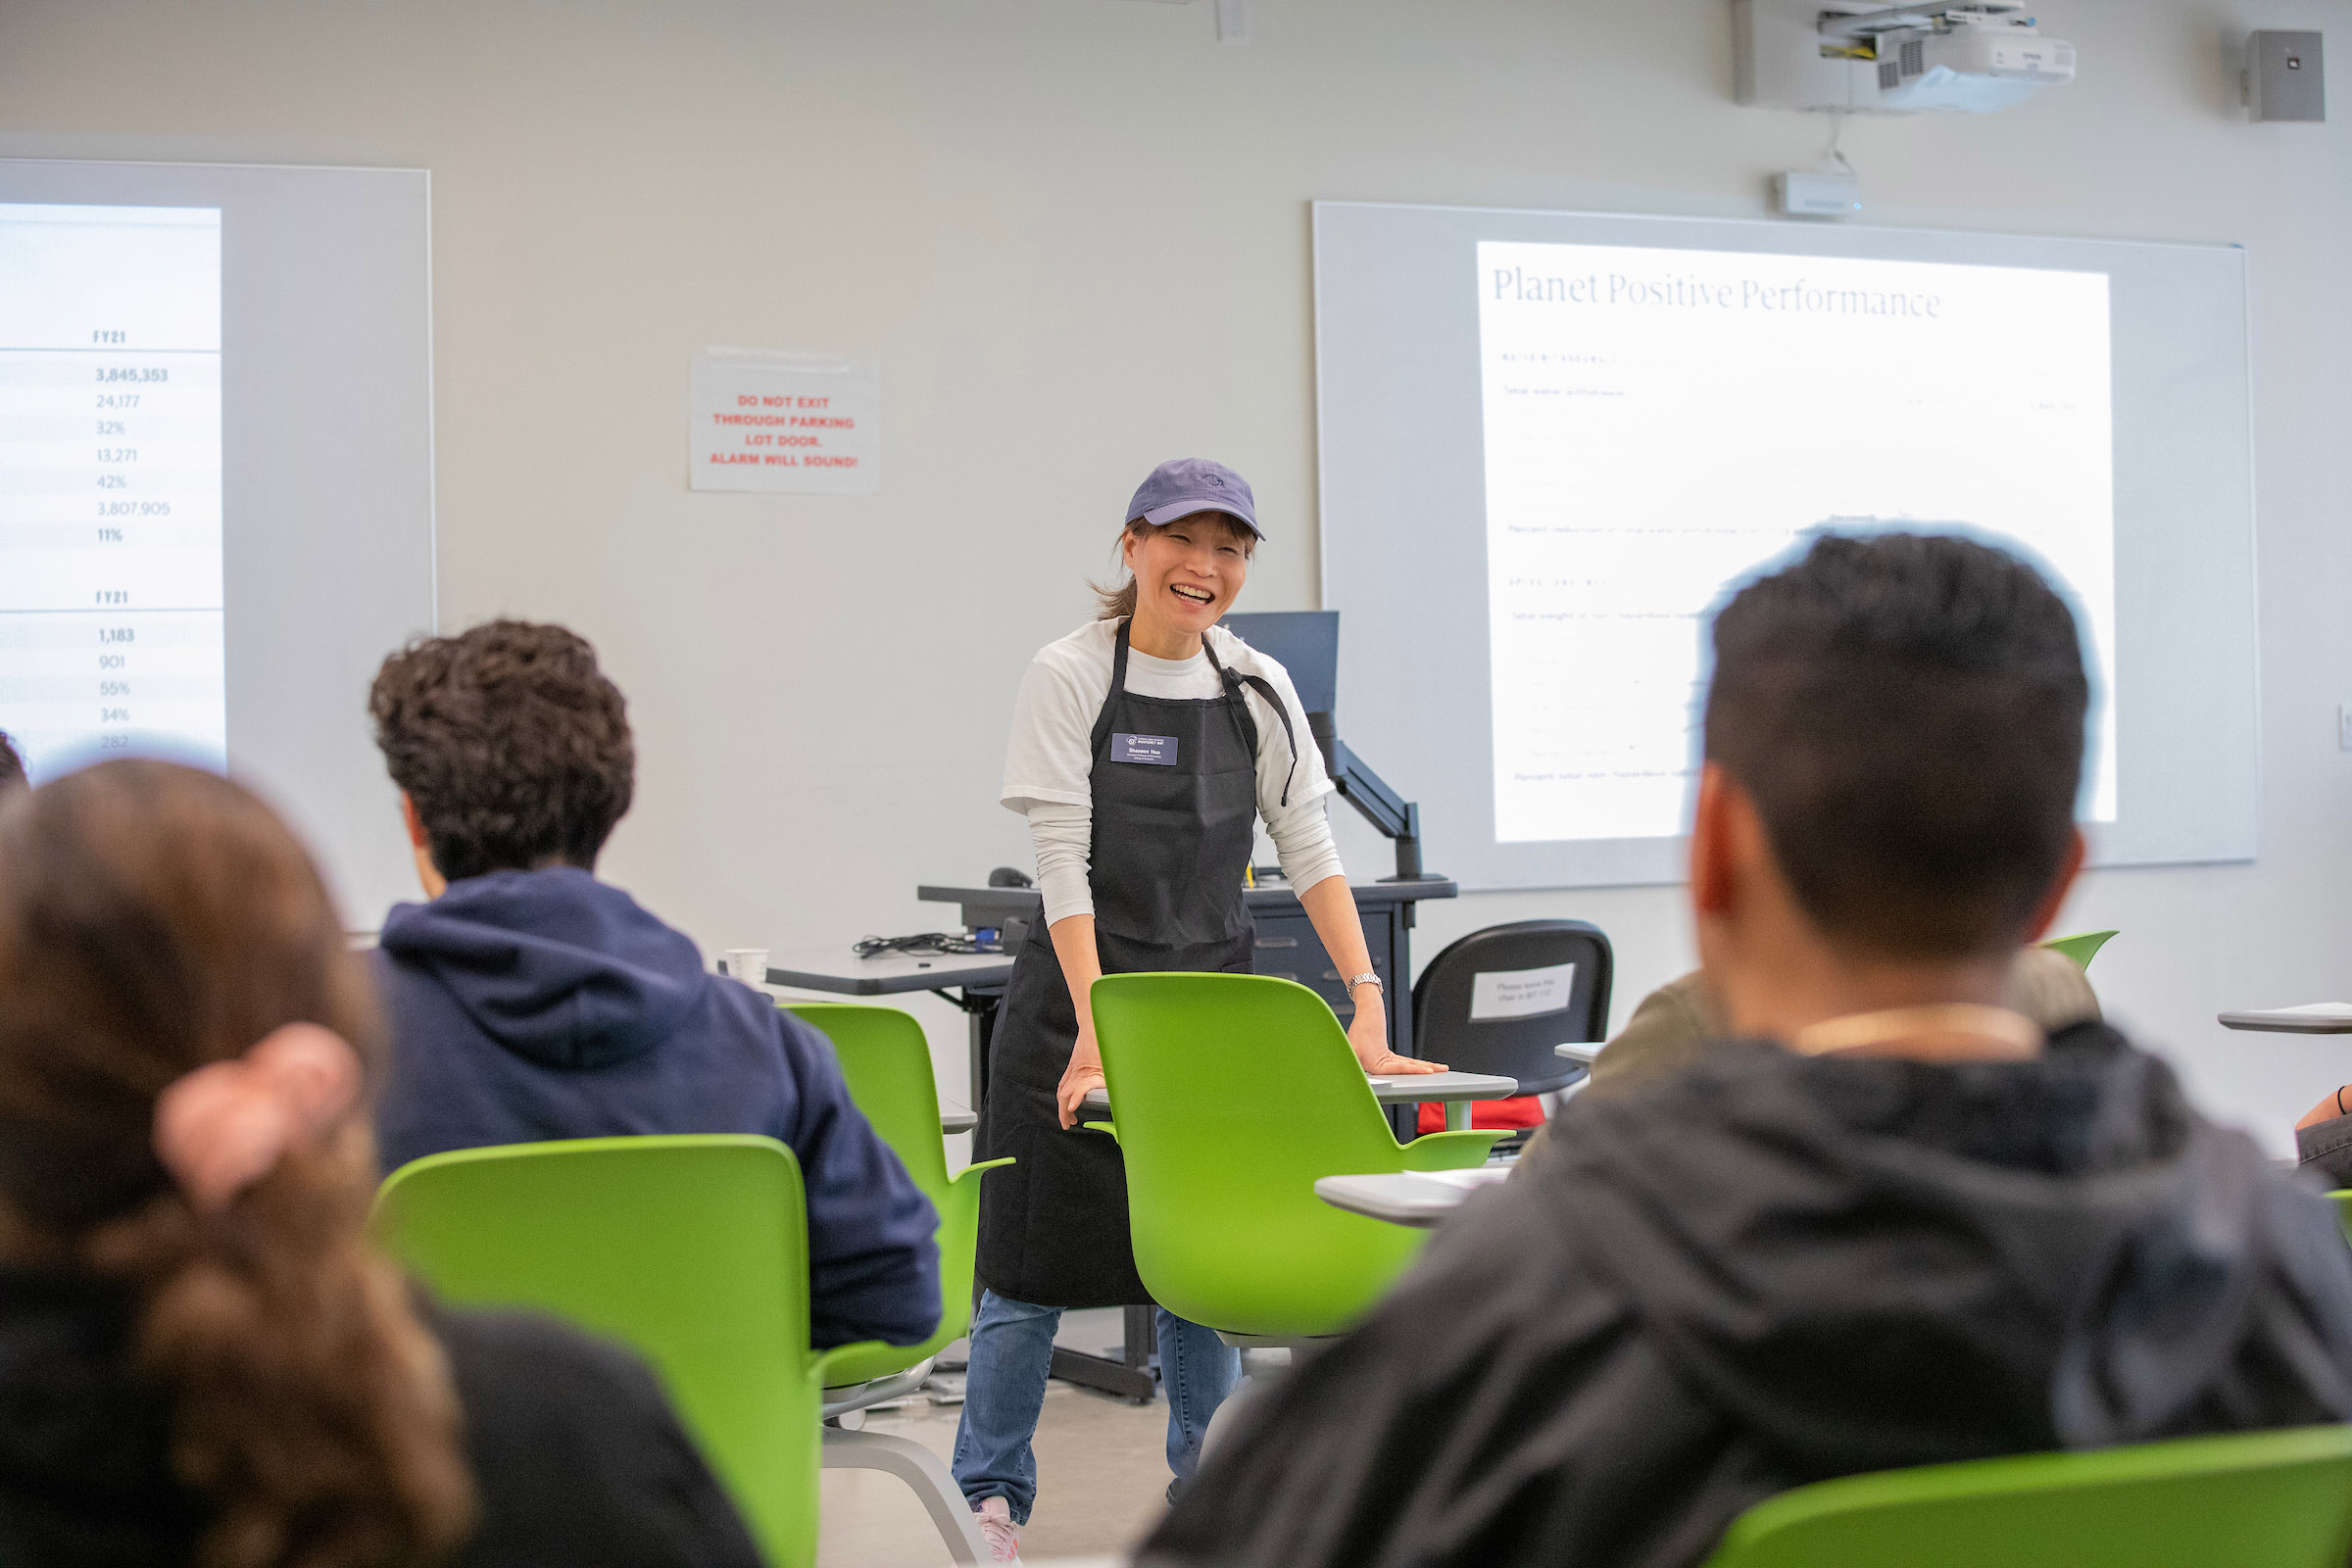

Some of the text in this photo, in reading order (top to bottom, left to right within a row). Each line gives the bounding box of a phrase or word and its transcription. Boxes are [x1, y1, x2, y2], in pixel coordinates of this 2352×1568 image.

[1494, 266, 1940, 318] Planet Positive Performance
[93, 329, 125, 344] FY21
[95, 368, 169, 384] 3,845,353
[96, 394, 140, 410] 24,177
[738, 395, 830, 409] DO NOT EXIT
[96, 420, 126, 435] 32%
[713, 413, 855, 429] THROUGH PARKING
[745, 434, 773, 446] LOT
[97, 448, 138, 463] 13,271
[710, 453, 858, 468] ALARM WILL SOUND!
[97, 474, 127, 489] 42%
[97, 501, 171, 516] 3,807,905
[98, 528, 123, 542] 11%
[96, 590, 128, 604] FY21
[99, 628, 135, 644] 1,183
[99, 655, 125, 668] 901
[100, 681, 130, 696] 55%
[101, 708, 130, 722] 34%
[101, 735, 129, 749] 282
